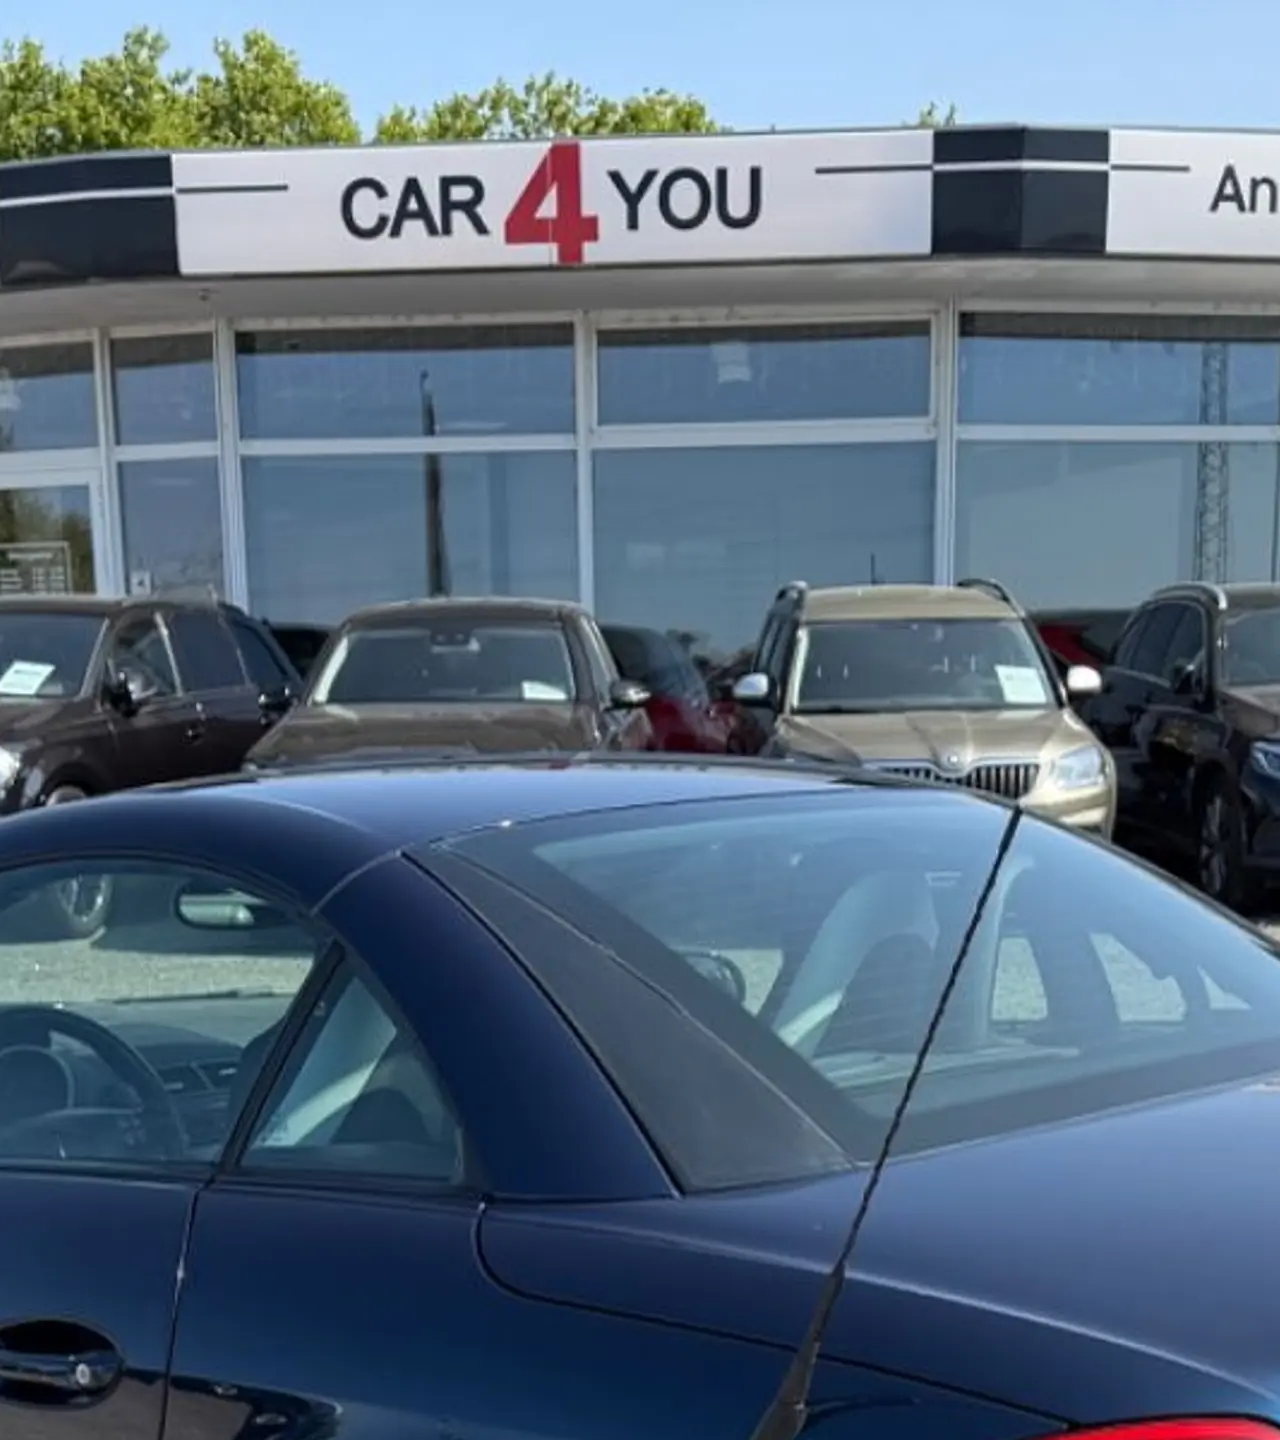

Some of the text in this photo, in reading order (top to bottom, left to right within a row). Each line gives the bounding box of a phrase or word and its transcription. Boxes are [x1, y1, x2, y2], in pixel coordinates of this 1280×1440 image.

[340, 142, 762, 265] CAR 4 YOU
[1209, 164, 1279, 214] An
